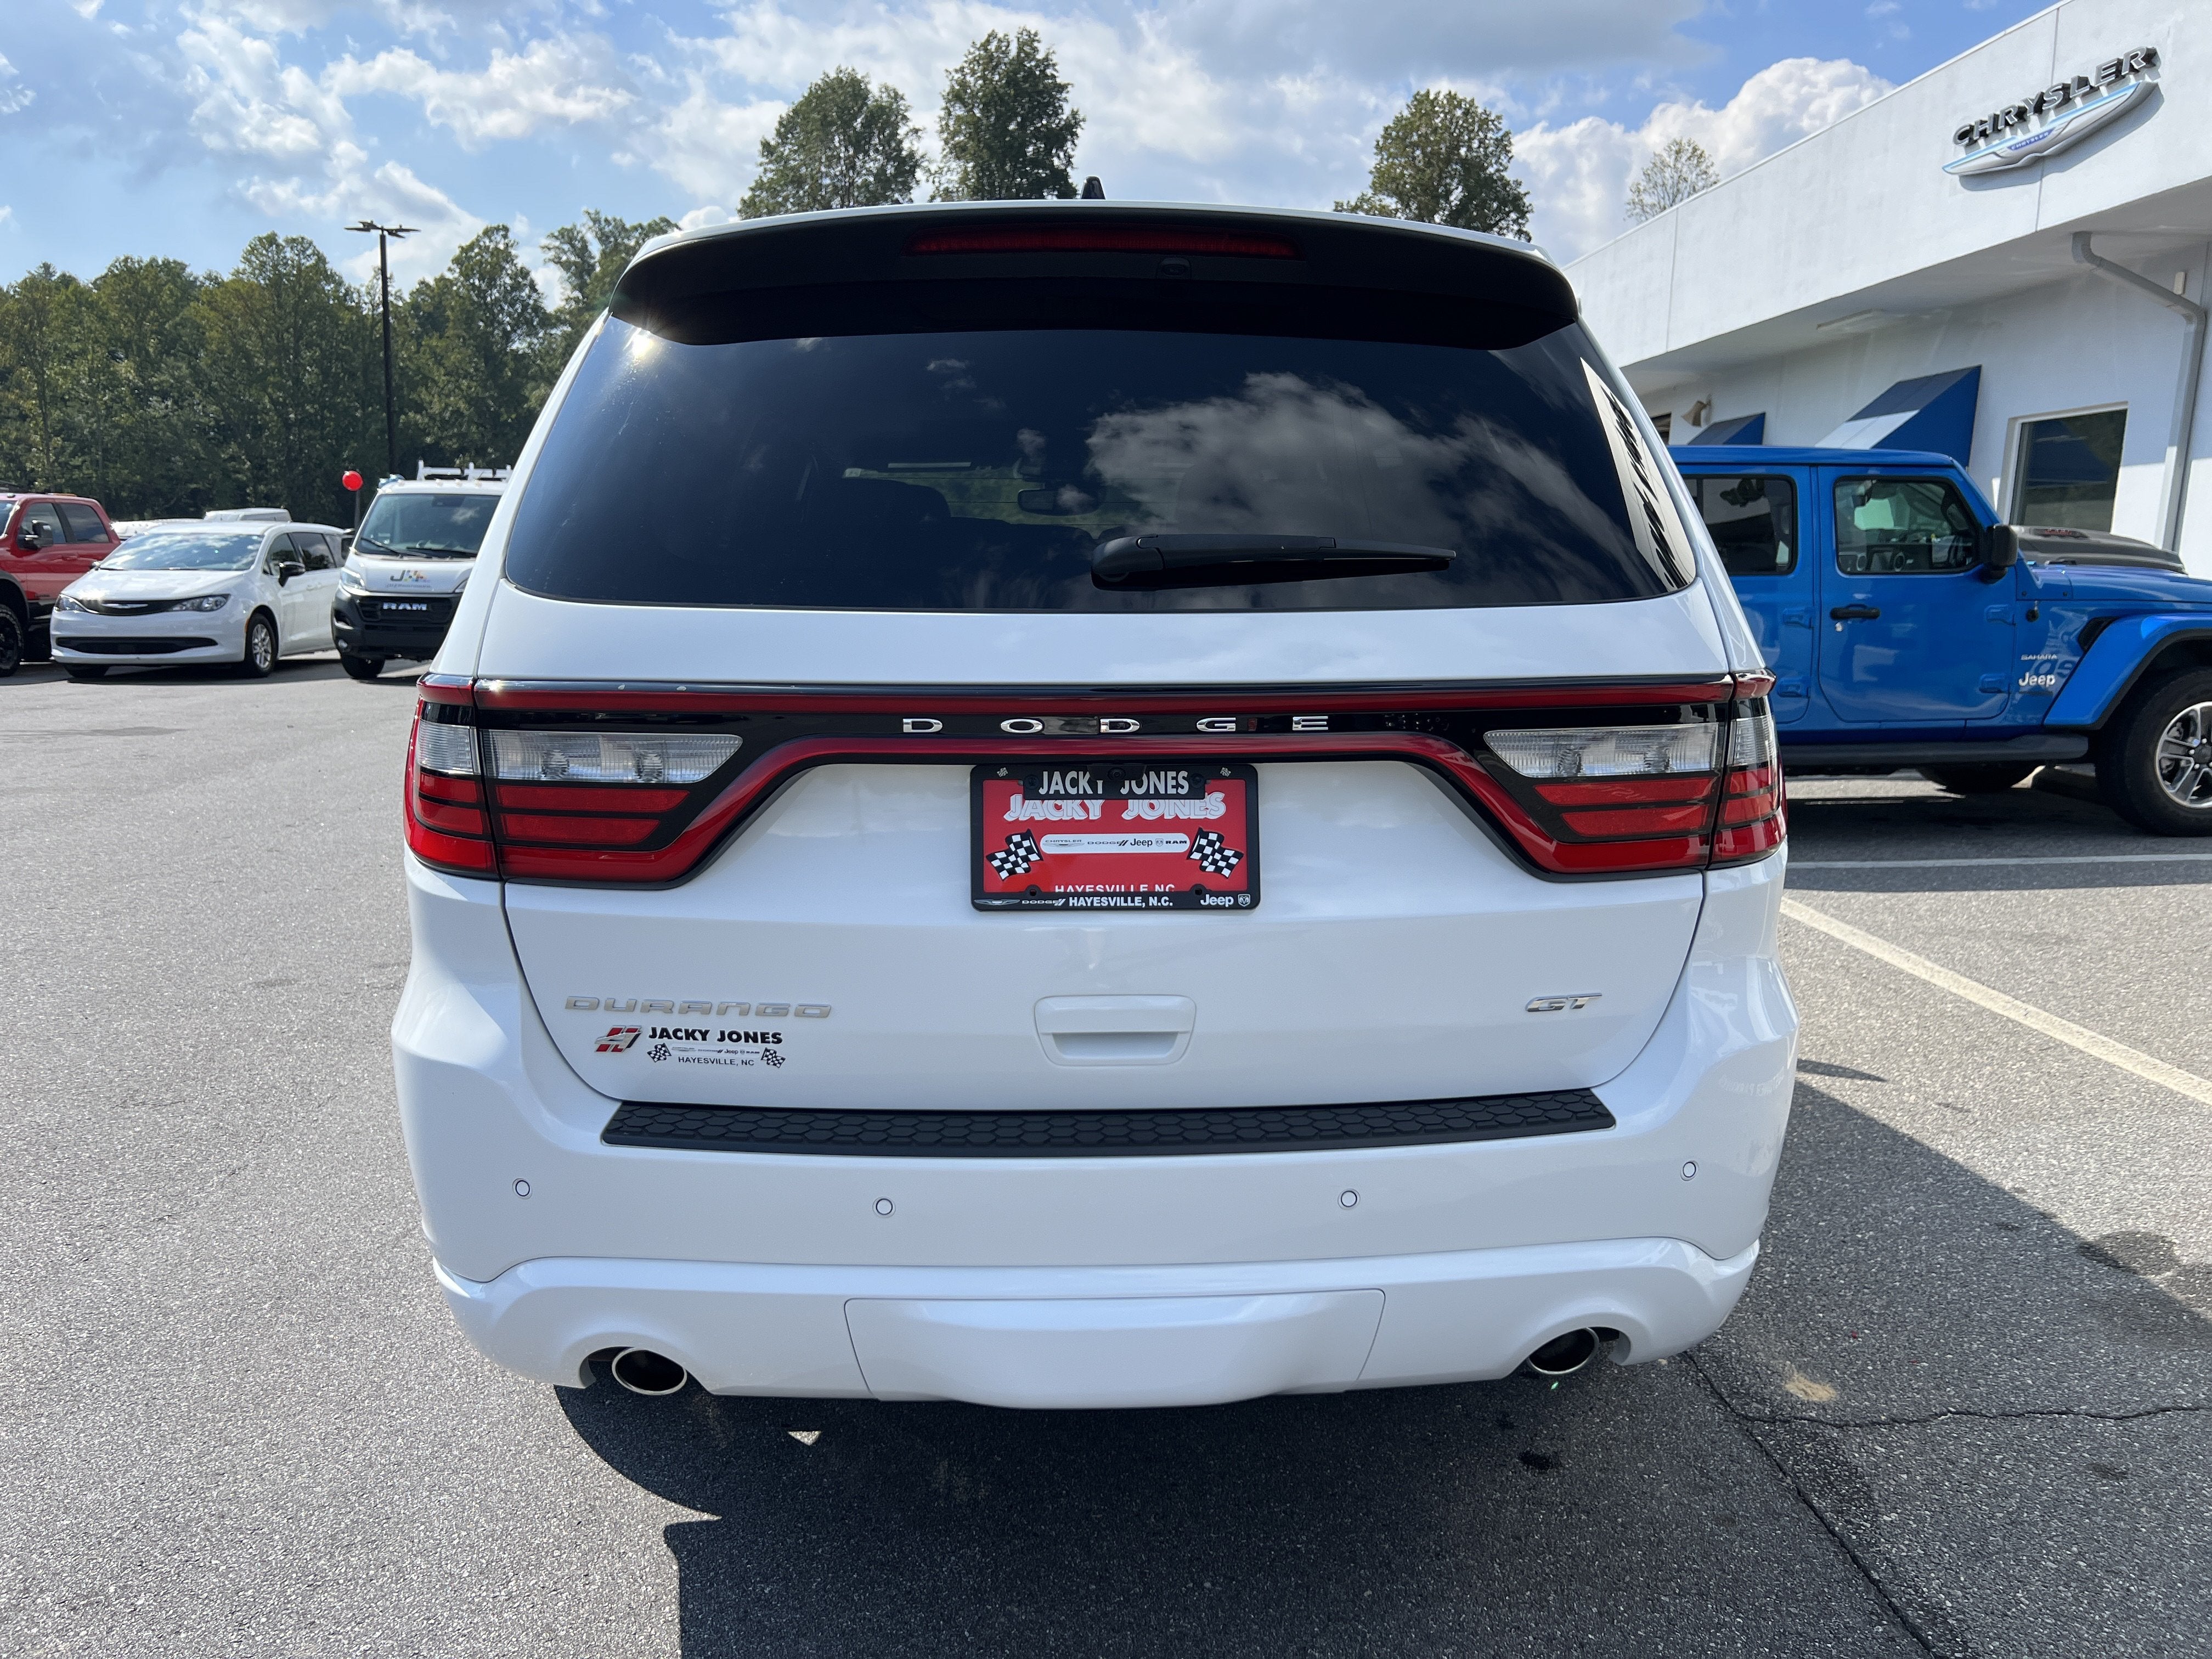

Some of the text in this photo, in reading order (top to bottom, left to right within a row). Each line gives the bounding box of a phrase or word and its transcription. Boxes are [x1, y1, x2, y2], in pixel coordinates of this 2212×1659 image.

[1953, 47, 2159, 146] CHRYSLER
[383, 602, 427, 611] RAM
[2018, 672, 2056, 687] Jeep
[902, 715, 1329, 733] DODGE
[1120, 770, 1189, 794] JONES
[1003, 792, 1226, 821] JACKY JONES
[1130, 838, 1153, 848] Jeep
[1069, 896, 1146, 909] HAYESVILLE,
[1149, 896, 1173, 906] N.C.
[1200, 894, 1234, 907] Jeep
[565, 996, 832, 1018] DURANGO
[1525, 992, 1602, 1012] GT
[648, 1026, 783, 1045] JACKY JONES
[678, 1056, 738, 1066] HAYESVILLE,
